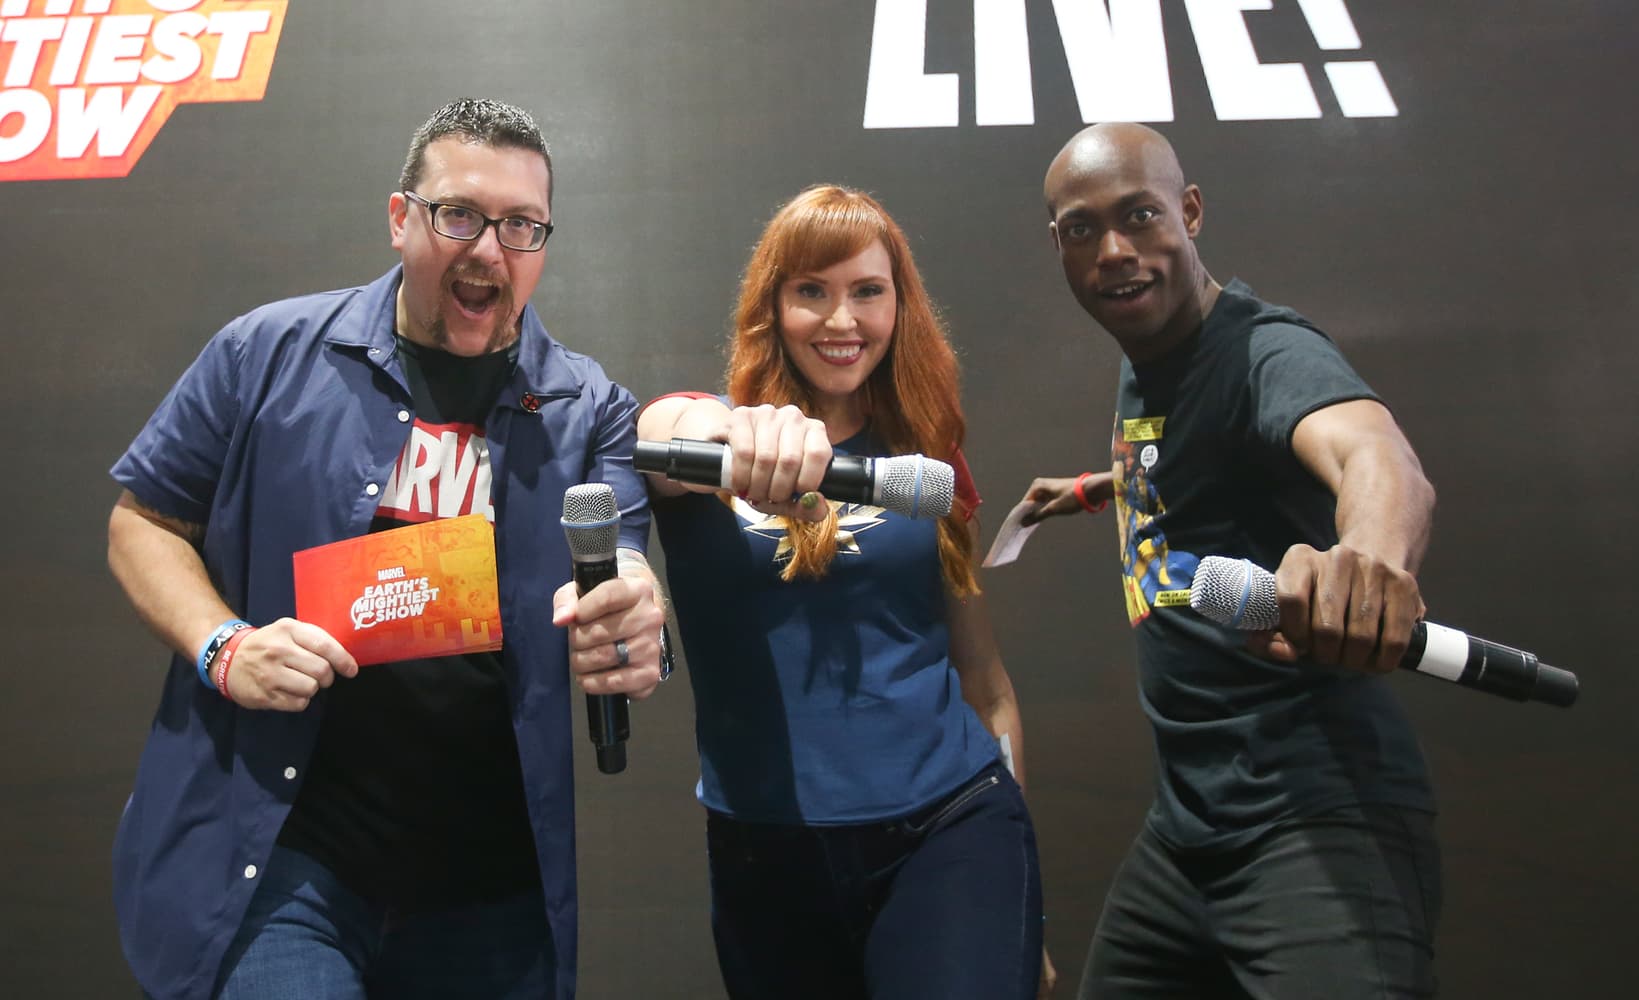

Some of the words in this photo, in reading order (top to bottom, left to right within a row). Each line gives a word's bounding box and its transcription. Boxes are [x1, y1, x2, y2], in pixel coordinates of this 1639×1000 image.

[0, 10, 271, 88] TIEST
[378, 567, 405, 581] MARVEL
[365, 577, 429, 599] EARTH'S
[355, 587, 439, 612] MIGHTIEST
[376, 602, 425, 622] SHOW
